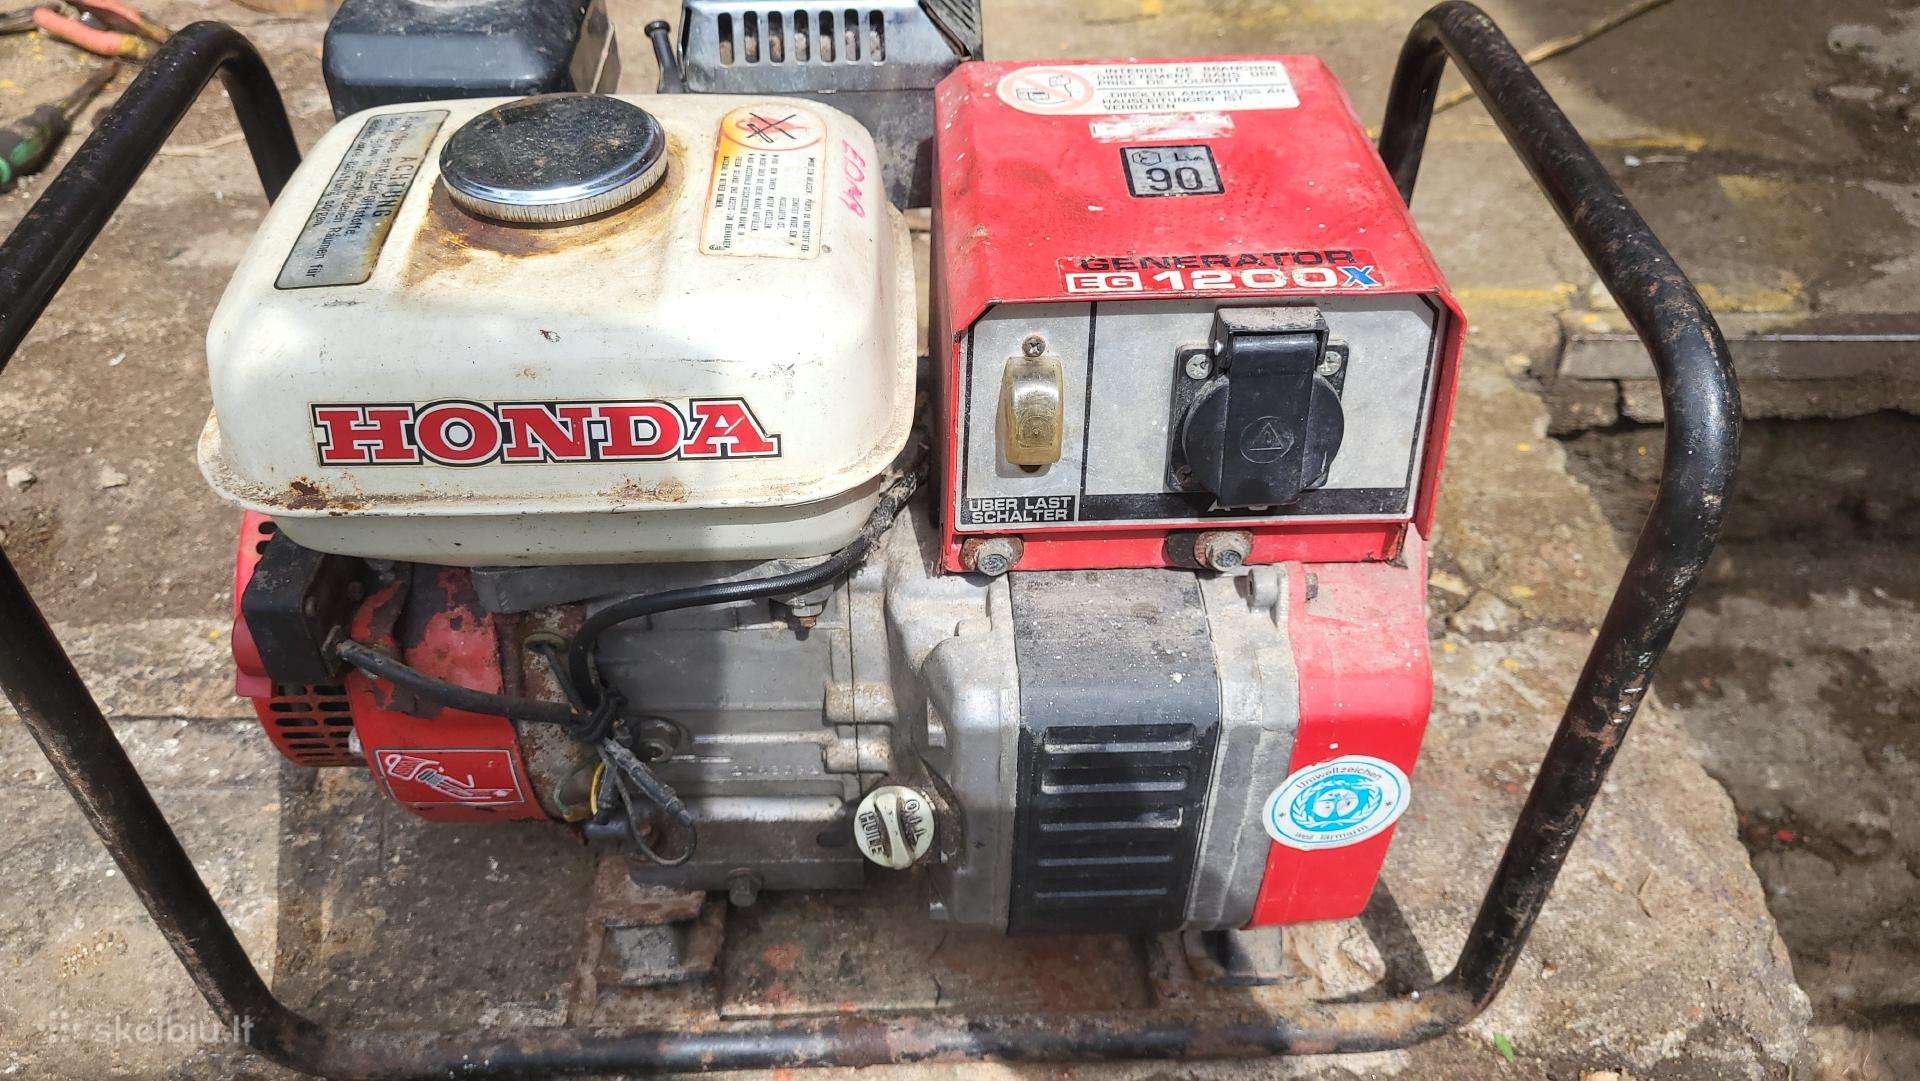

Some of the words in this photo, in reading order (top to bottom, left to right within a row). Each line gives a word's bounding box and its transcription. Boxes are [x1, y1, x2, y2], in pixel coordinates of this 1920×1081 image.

[373, 157, 415, 217] ACHTUNG
[1146, 166, 1204, 192] 90
[315, 227, 343, 259] Räumen
[304, 264, 323, 278] für
[1081, 250, 1355, 271] GENERATOR
[309, 397, 782, 467] HONDA
[971, 508, 1069, 524] SCHALTER
[1025, 496, 1072, 510] LAST
[859, 811, 885, 856] HUILE
